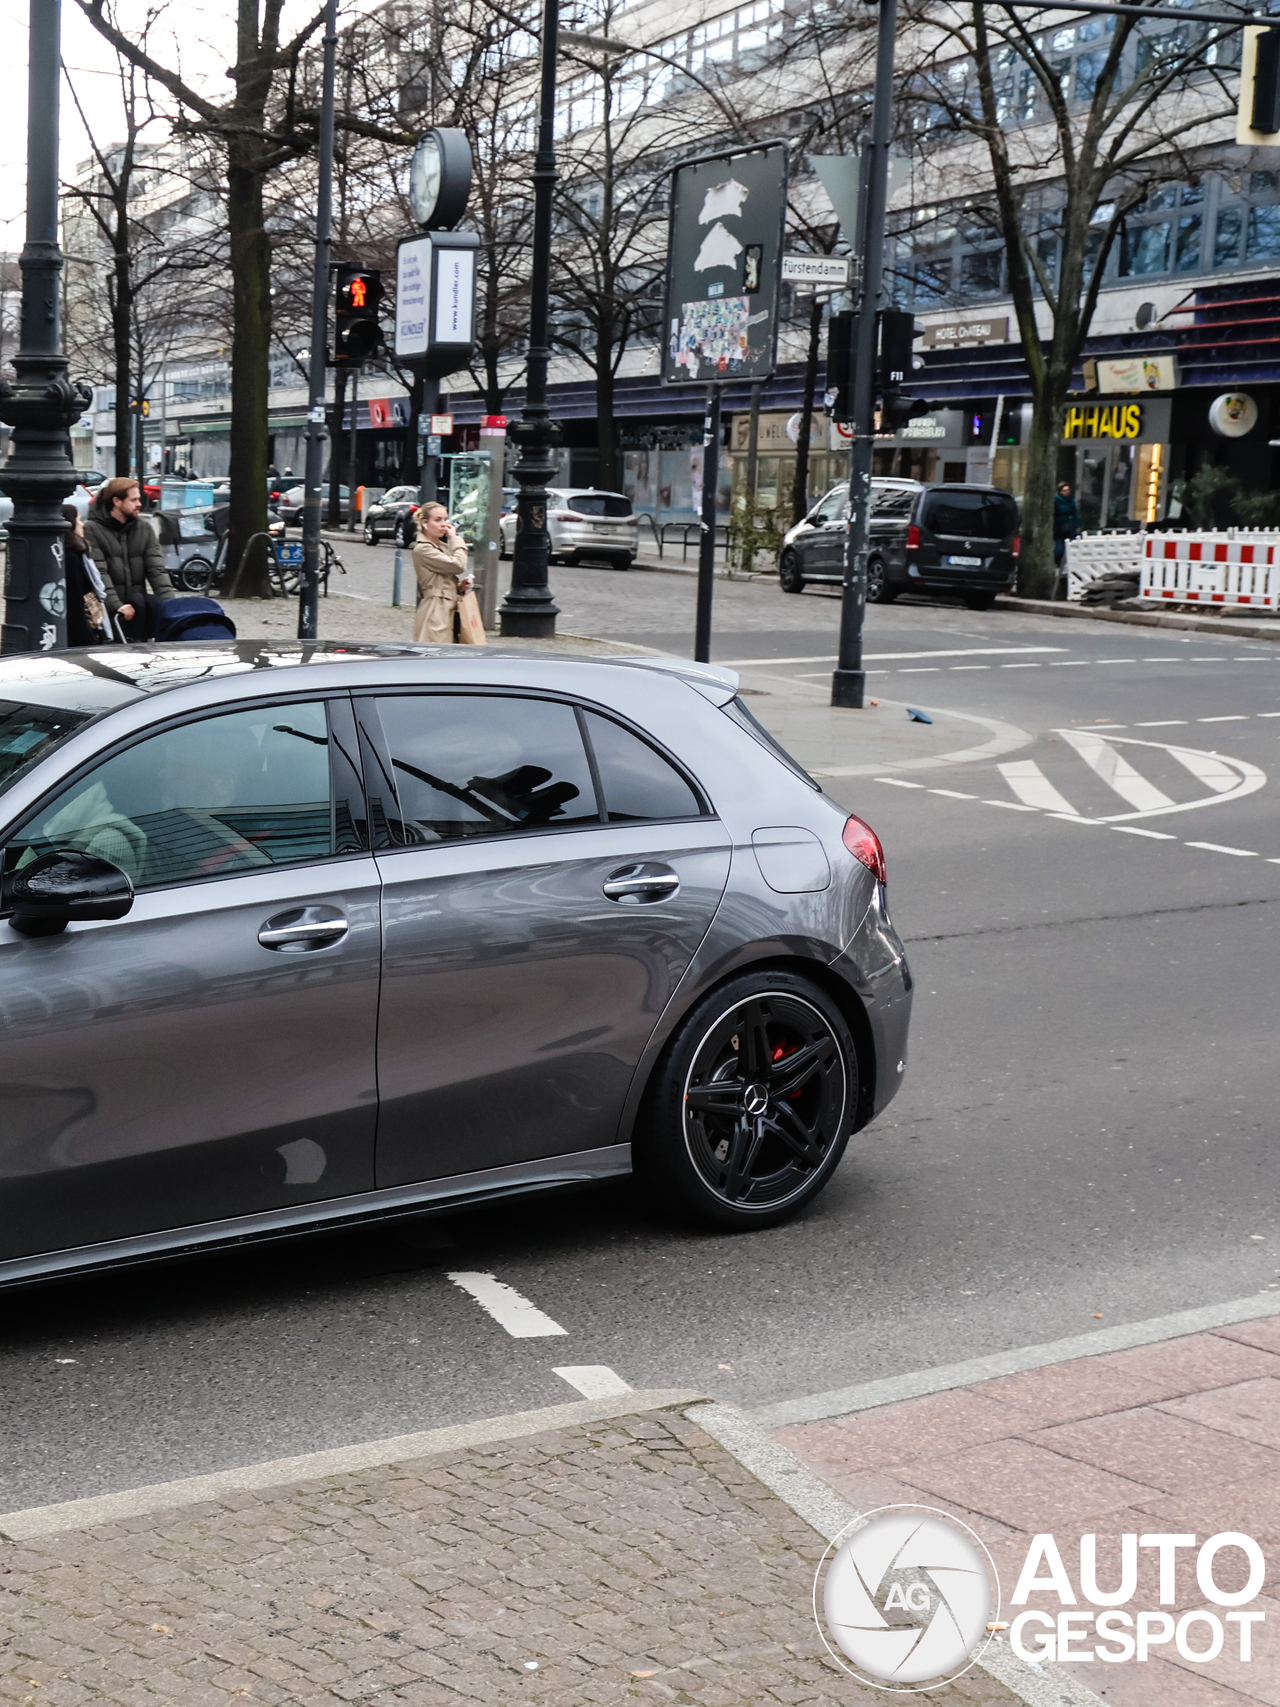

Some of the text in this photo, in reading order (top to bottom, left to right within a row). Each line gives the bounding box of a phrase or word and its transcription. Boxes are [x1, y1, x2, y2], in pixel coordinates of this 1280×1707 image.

[451, 261, 460, 331] www.kundler.com
[935, 327, 958, 340] HOTEL
[890, 371, 904, 381] F11
